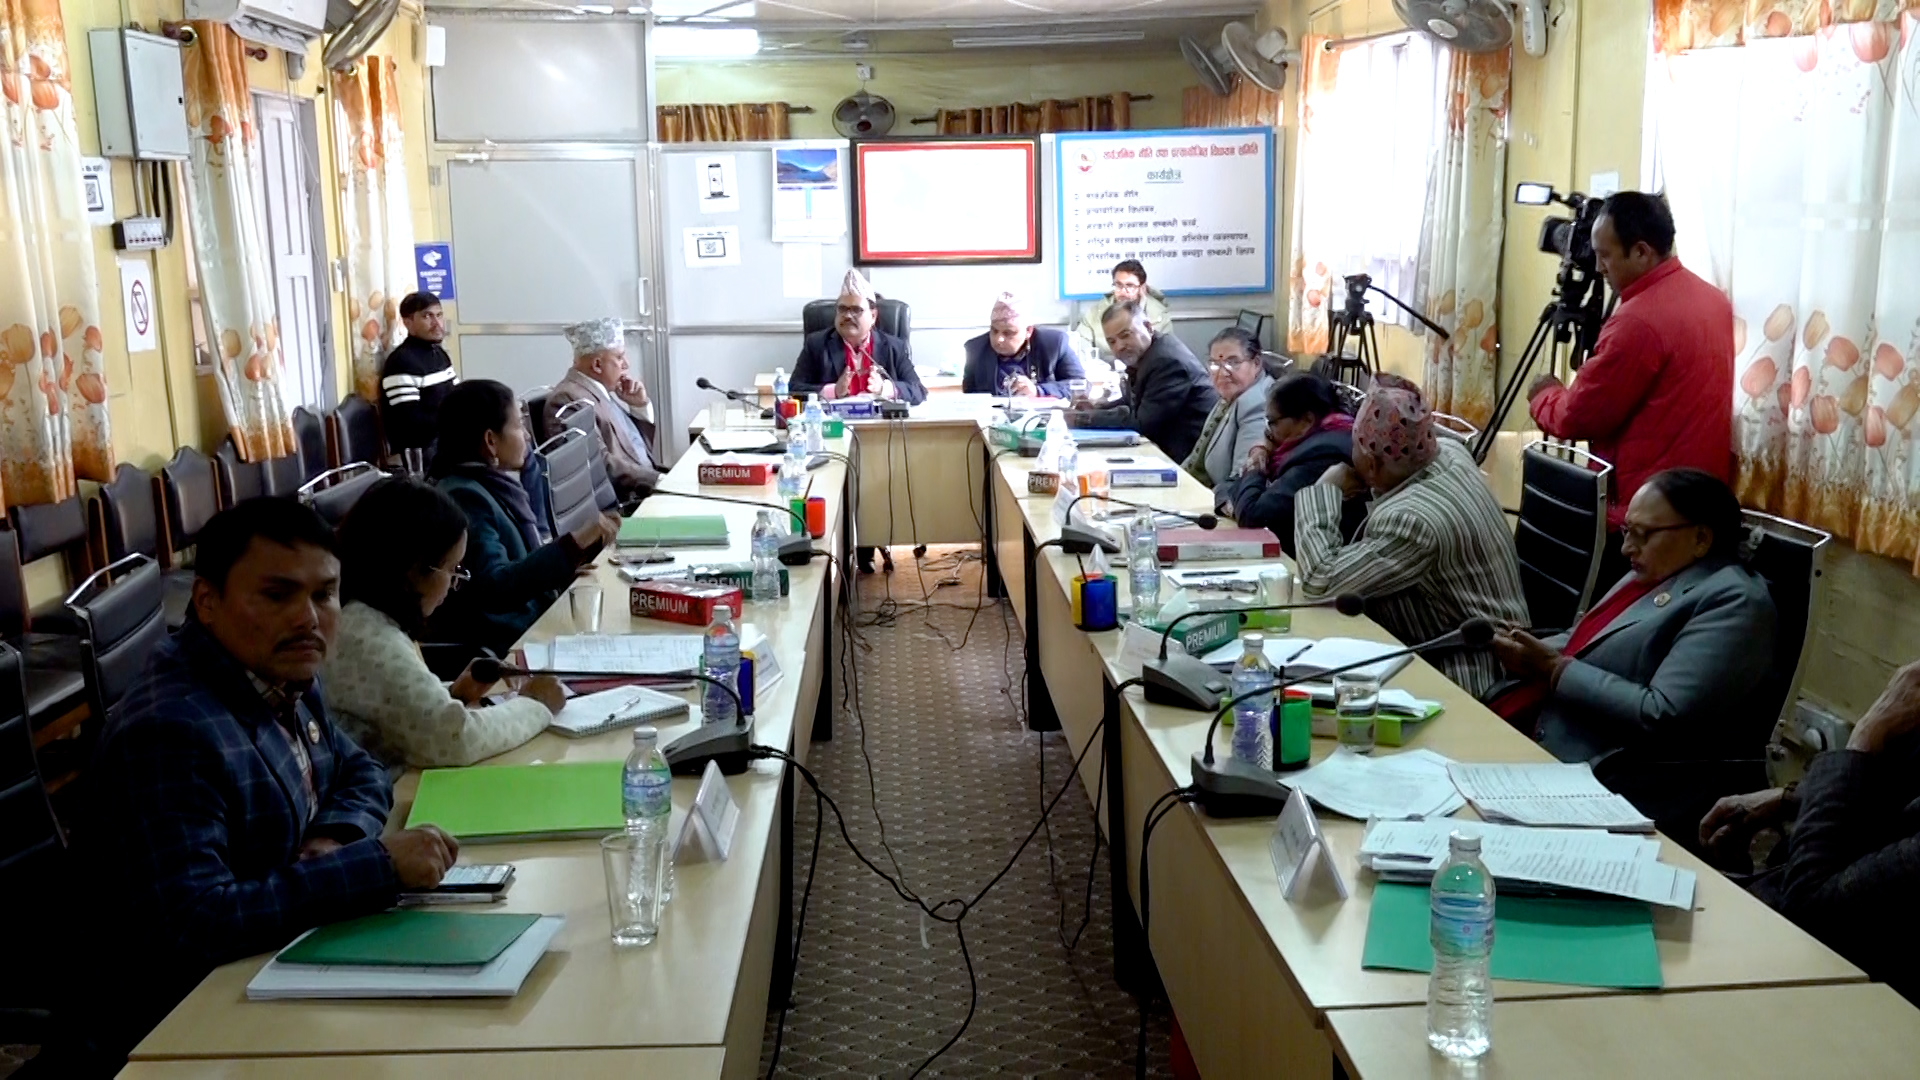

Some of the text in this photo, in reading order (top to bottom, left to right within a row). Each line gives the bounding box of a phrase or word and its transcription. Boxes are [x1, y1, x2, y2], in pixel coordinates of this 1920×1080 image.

[700, 467, 751, 478] PREMIUM
[631, 591, 689, 614] PREMIUM
[1185, 619, 1228, 650] PREMIUM
